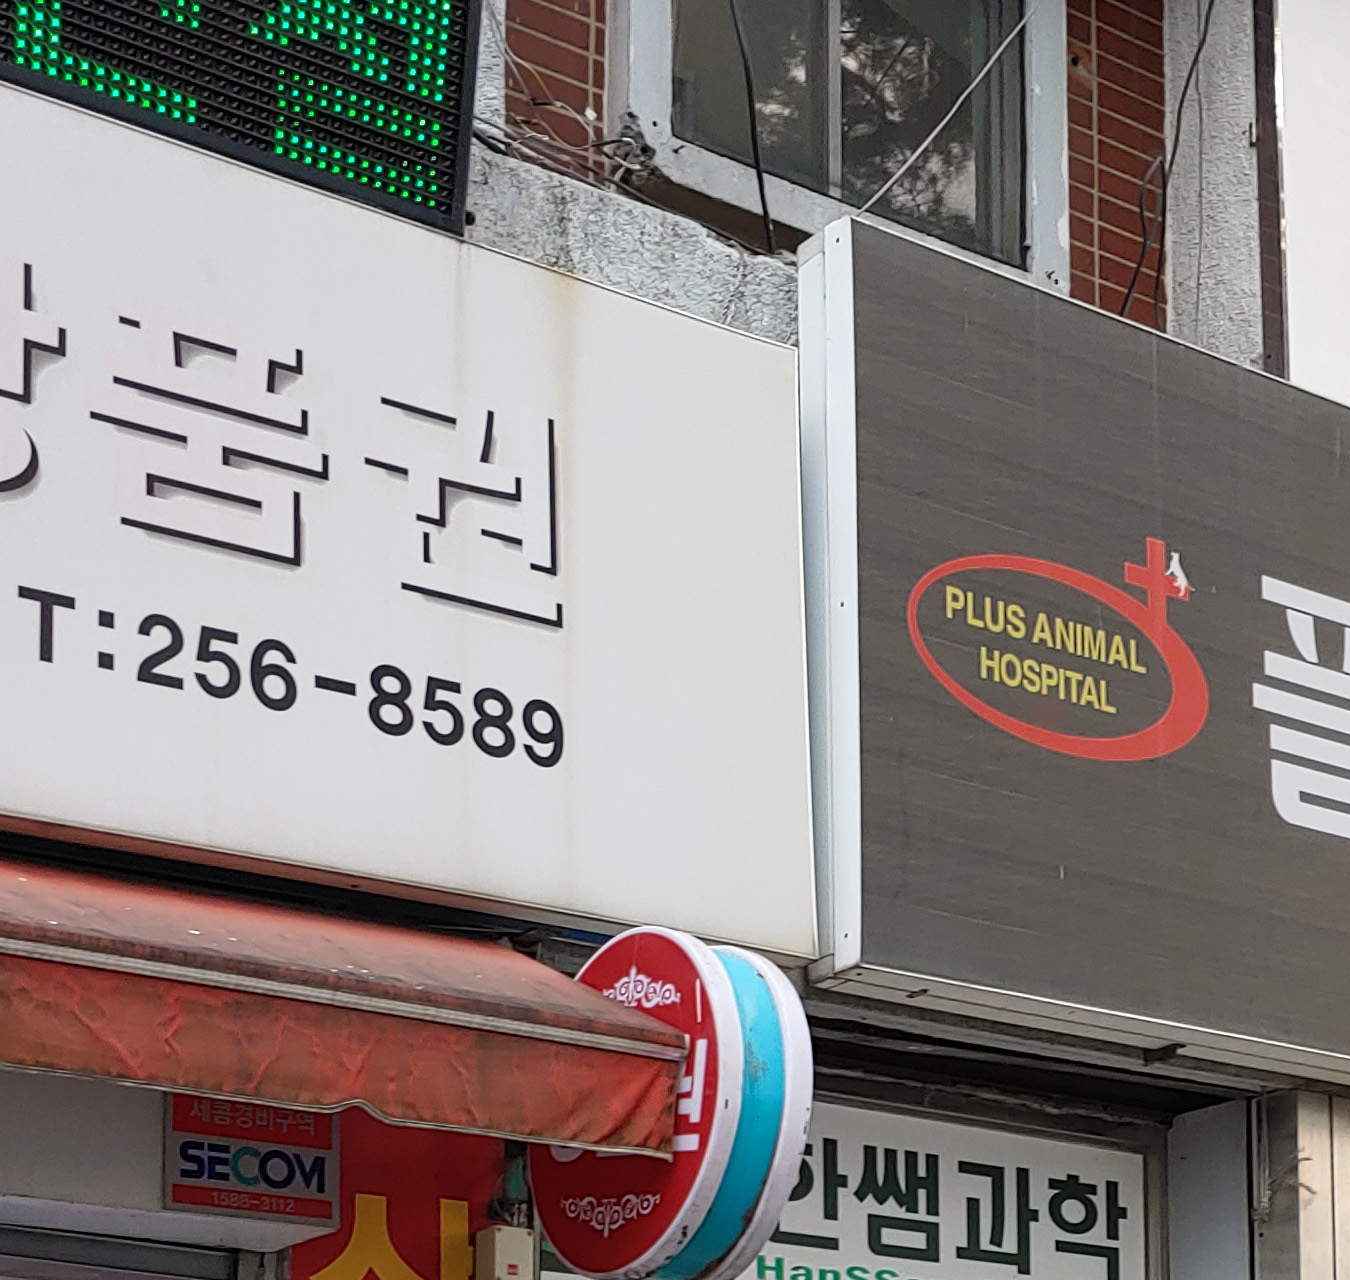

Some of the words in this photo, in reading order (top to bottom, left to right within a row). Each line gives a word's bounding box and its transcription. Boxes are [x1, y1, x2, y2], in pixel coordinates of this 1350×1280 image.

[945, 585, 1027, 640] PLUS
[1031, 611, 1148, 674] ANIMAL
[18, 585, 565, 768] T:256-8589
[979, 646, 1117, 714] HOSPITAL
[189, 1098, 316, 1136] 세콤경비구역
[179, 1140, 327, 1194] SECOM
[212, 1190, 296, 1214] 1588-3112
